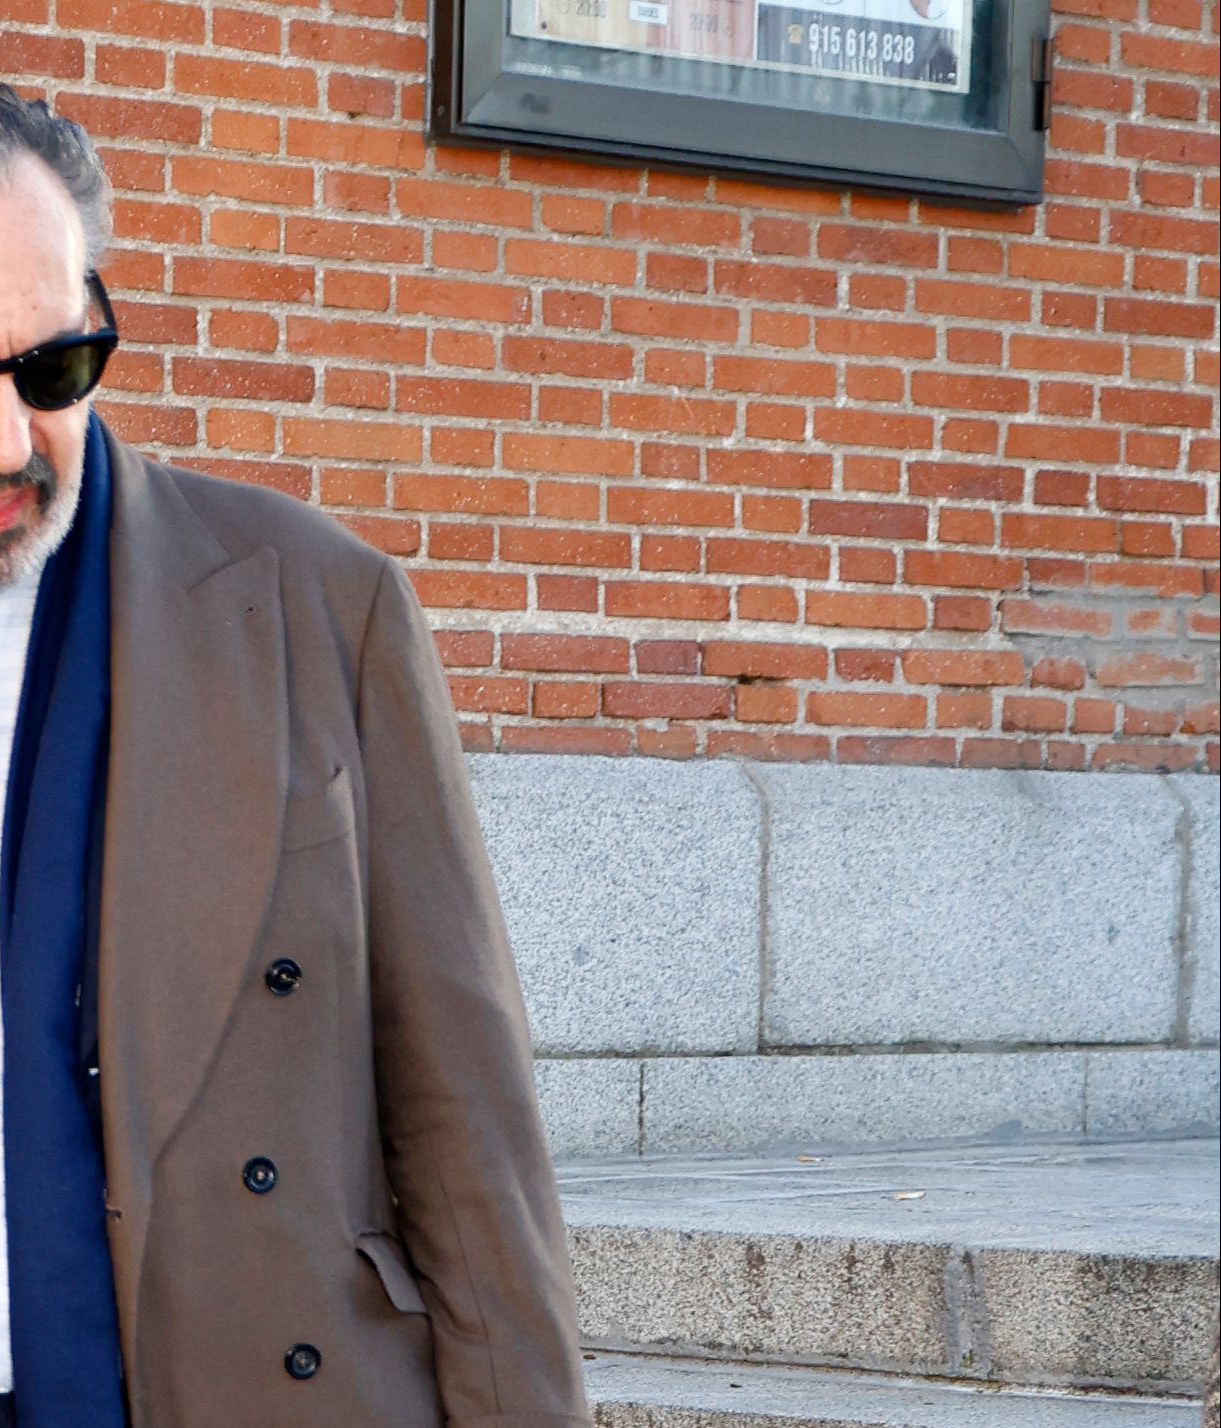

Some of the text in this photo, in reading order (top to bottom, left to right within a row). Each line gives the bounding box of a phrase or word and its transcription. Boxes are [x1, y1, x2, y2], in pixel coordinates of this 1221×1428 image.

[808, 22, 915, 65] 915 613 838
